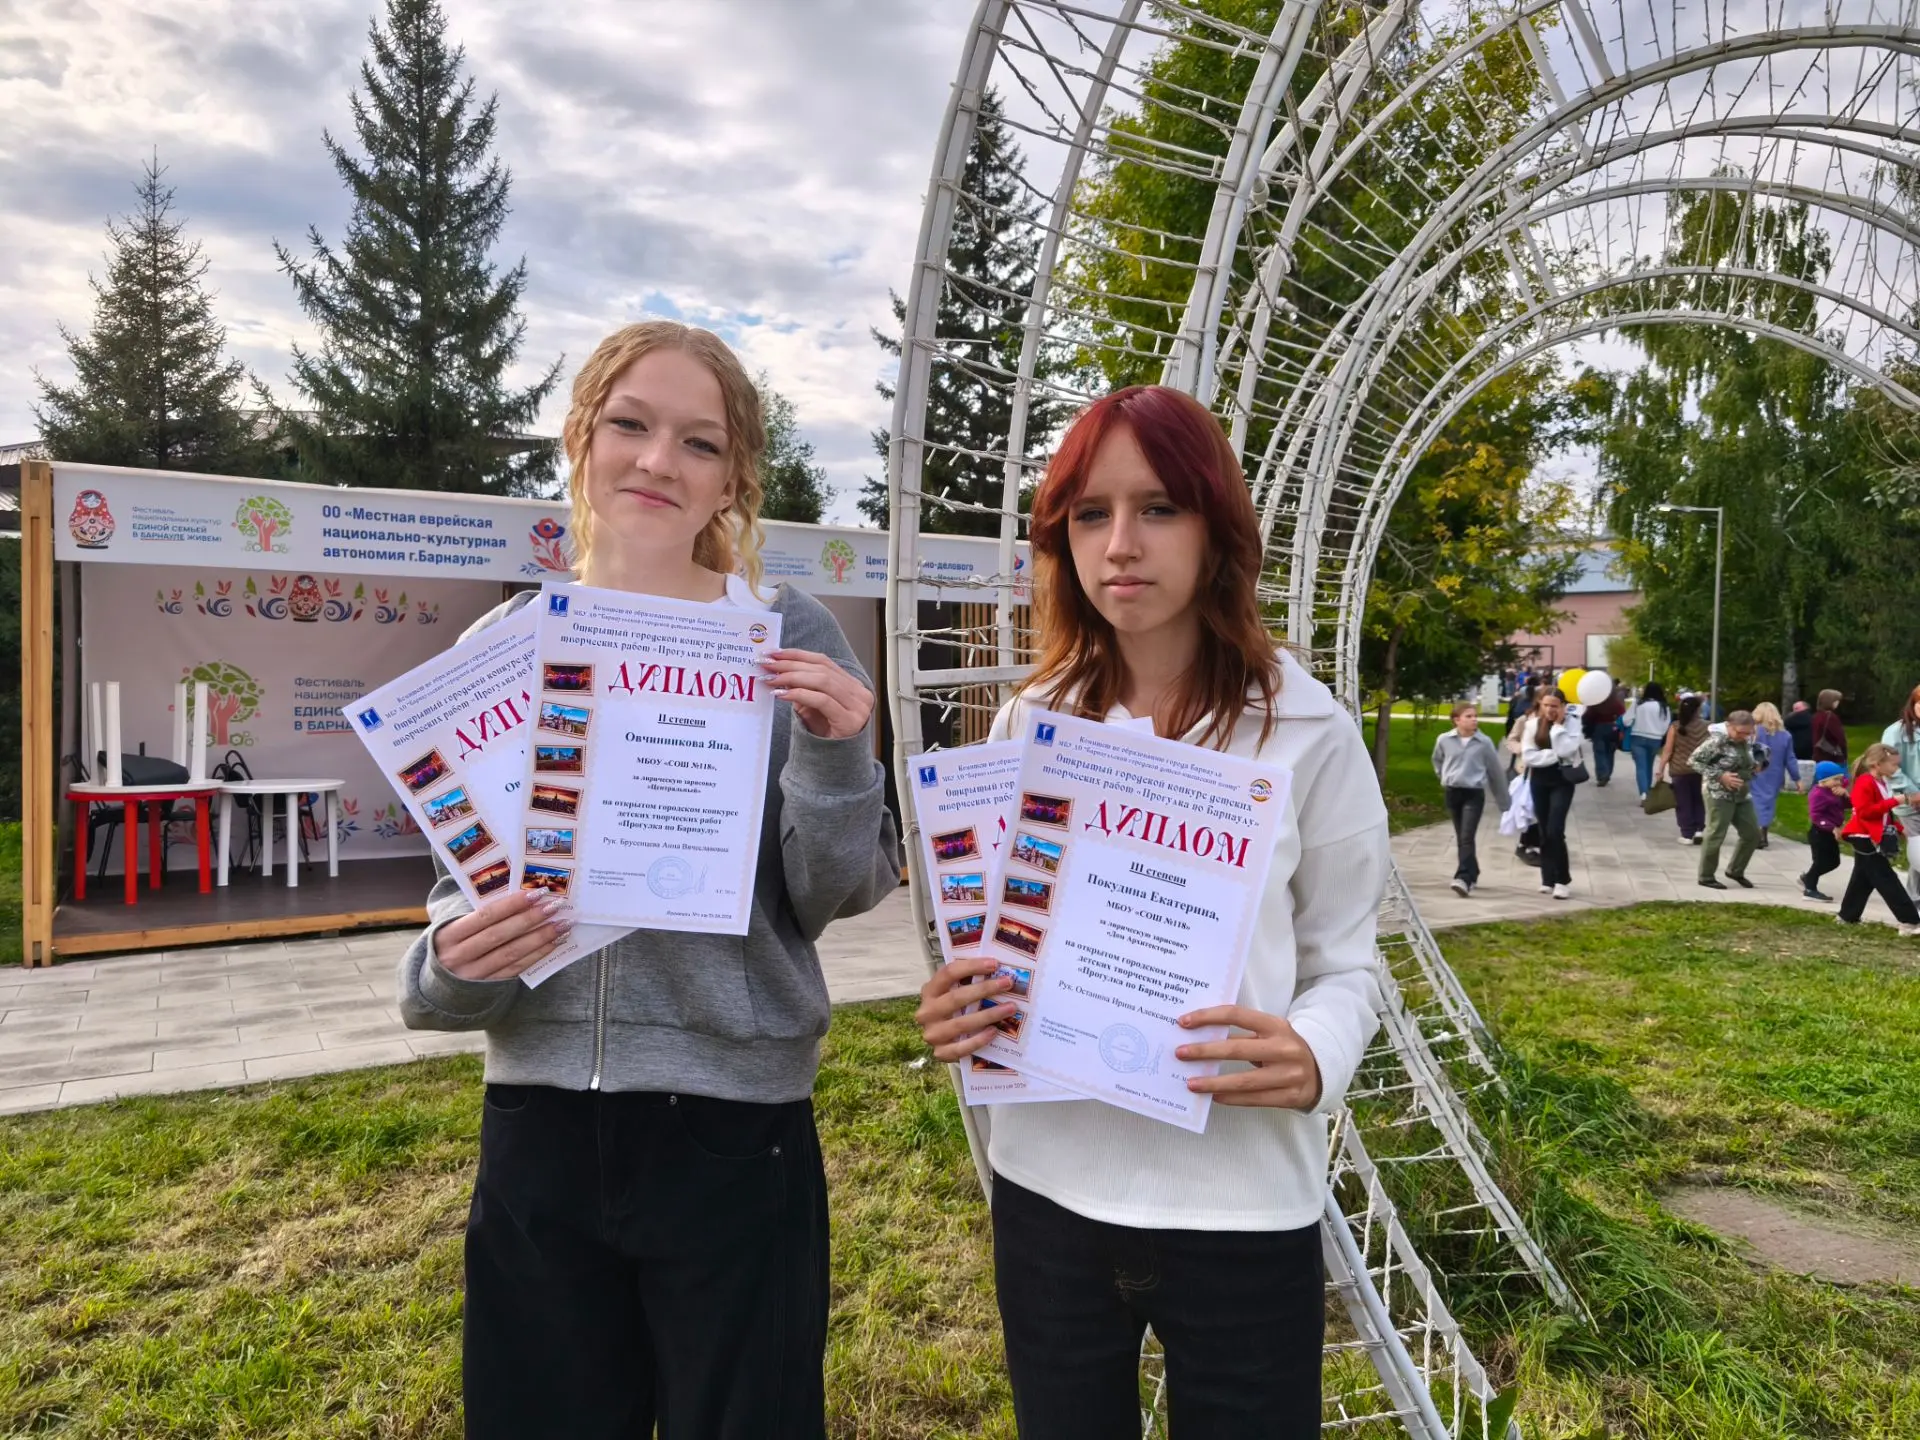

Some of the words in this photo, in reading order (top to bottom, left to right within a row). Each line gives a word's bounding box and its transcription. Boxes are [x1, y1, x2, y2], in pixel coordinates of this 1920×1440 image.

[132, 506, 175, 515] Фестиваль
[345, 507, 416, 524] «Местная
[419, 514, 493, 529] еврейская
[132, 523, 170, 532] ЕДИНОЙ
[171, 525, 207, 533] СЕМЬЕЙ
[141, 532, 185, 541] БАРНАУЛЕ
[323, 527, 507, 549] национально-культурная
[323, 547, 405, 561] автономия
[409, 550, 491, 566] г.Барнаула»
[560, 635, 618, 649] творческих
[620, 642, 650, 653] работ
[703, 651, 714, 661] по
[573, 622, 628, 638] Открытый
[631, 631, 677, 643] городской
[679, 636, 715, 650] конкурс
[717, 642, 754, 653] детских
[294, 677, 365, 688] Фестиваль
[607, 660, 758, 702] ДИПЛОМ
[295, 691, 367, 700] националь
[393, 700, 443, 731] Открытый
[443, 677, 486, 704] городской
[487, 658, 521, 679] конкурс
[392, 714, 443, 748] творческих
[444, 700, 469, 720] работ
[517, 668, 527, 678] по
[294, 721, 303, 730] В
[668, 715, 706, 727] степени
[625, 731, 705, 750] Овчинникова
[637, 757, 662, 766] МБОУ
[664, 759, 690, 769] «СОШ
[684, 779, 717, 788] зарисовку
[945, 781, 997, 798] Открытый
[1056, 752, 1112, 776] Открытый
[1115, 769, 1165, 788] городской
[1167, 783, 1208, 800] конкурс
[1209, 795, 1252, 812] детских
[938, 797, 991, 812] творческих
[1042, 764, 1101, 785] творческих
[1103, 780, 1134, 794] работ
[1191, 802, 1204, 813] по
[1206, 804, 1260, 827] Барнаулу»
[614, 800, 656, 811] открытом
[658, 804, 700, 814] городском
[702, 808, 739, 818] конкурсе
[617, 811, 650, 819] детских
[652, 814, 698, 823] творческих
[699, 818, 722, 826] работ
[618, 820, 663, 831] «Прогулка
[677, 825, 719, 836] Барнаулу»
[1084, 800, 1252, 869] ДИПЛОМ
[661, 842, 681, 850] Анна
[1130, 861, 1144, 872] III
[1145, 866, 1187, 885] степени
[1087, 873, 1147, 899] Покудина
[1149, 891, 1220, 922] Екатерина,
[1106, 900, 1134, 913] МБОУ
[1135, 910, 1163, 922] «СОШ
[1106, 930, 1125, 940] «Дом
[1126, 935, 1176, 955] Архитектора»
[1108, 921, 1151, 938] лирическую
[1153, 934, 1189, 950] зарисовку
[1077, 943, 1120, 961] открытом
[1122, 957, 1167, 976] городском
[1168, 971, 1210, 989] конкурсе
[1078, 955, 1111, 970] детских
[1114, 966, 1162, 986] творческих
[1164, 981, 1190, 995] работ
[1077, 966, 1123, 985] «Прогулка
[1125, 981, 1136, 990] по
[1138, 984, 1185, 1005] Барнаулу»
[1111, 997, 1136, 1011] Ирина
[1137, 1006, 1178, 1026] Александр
